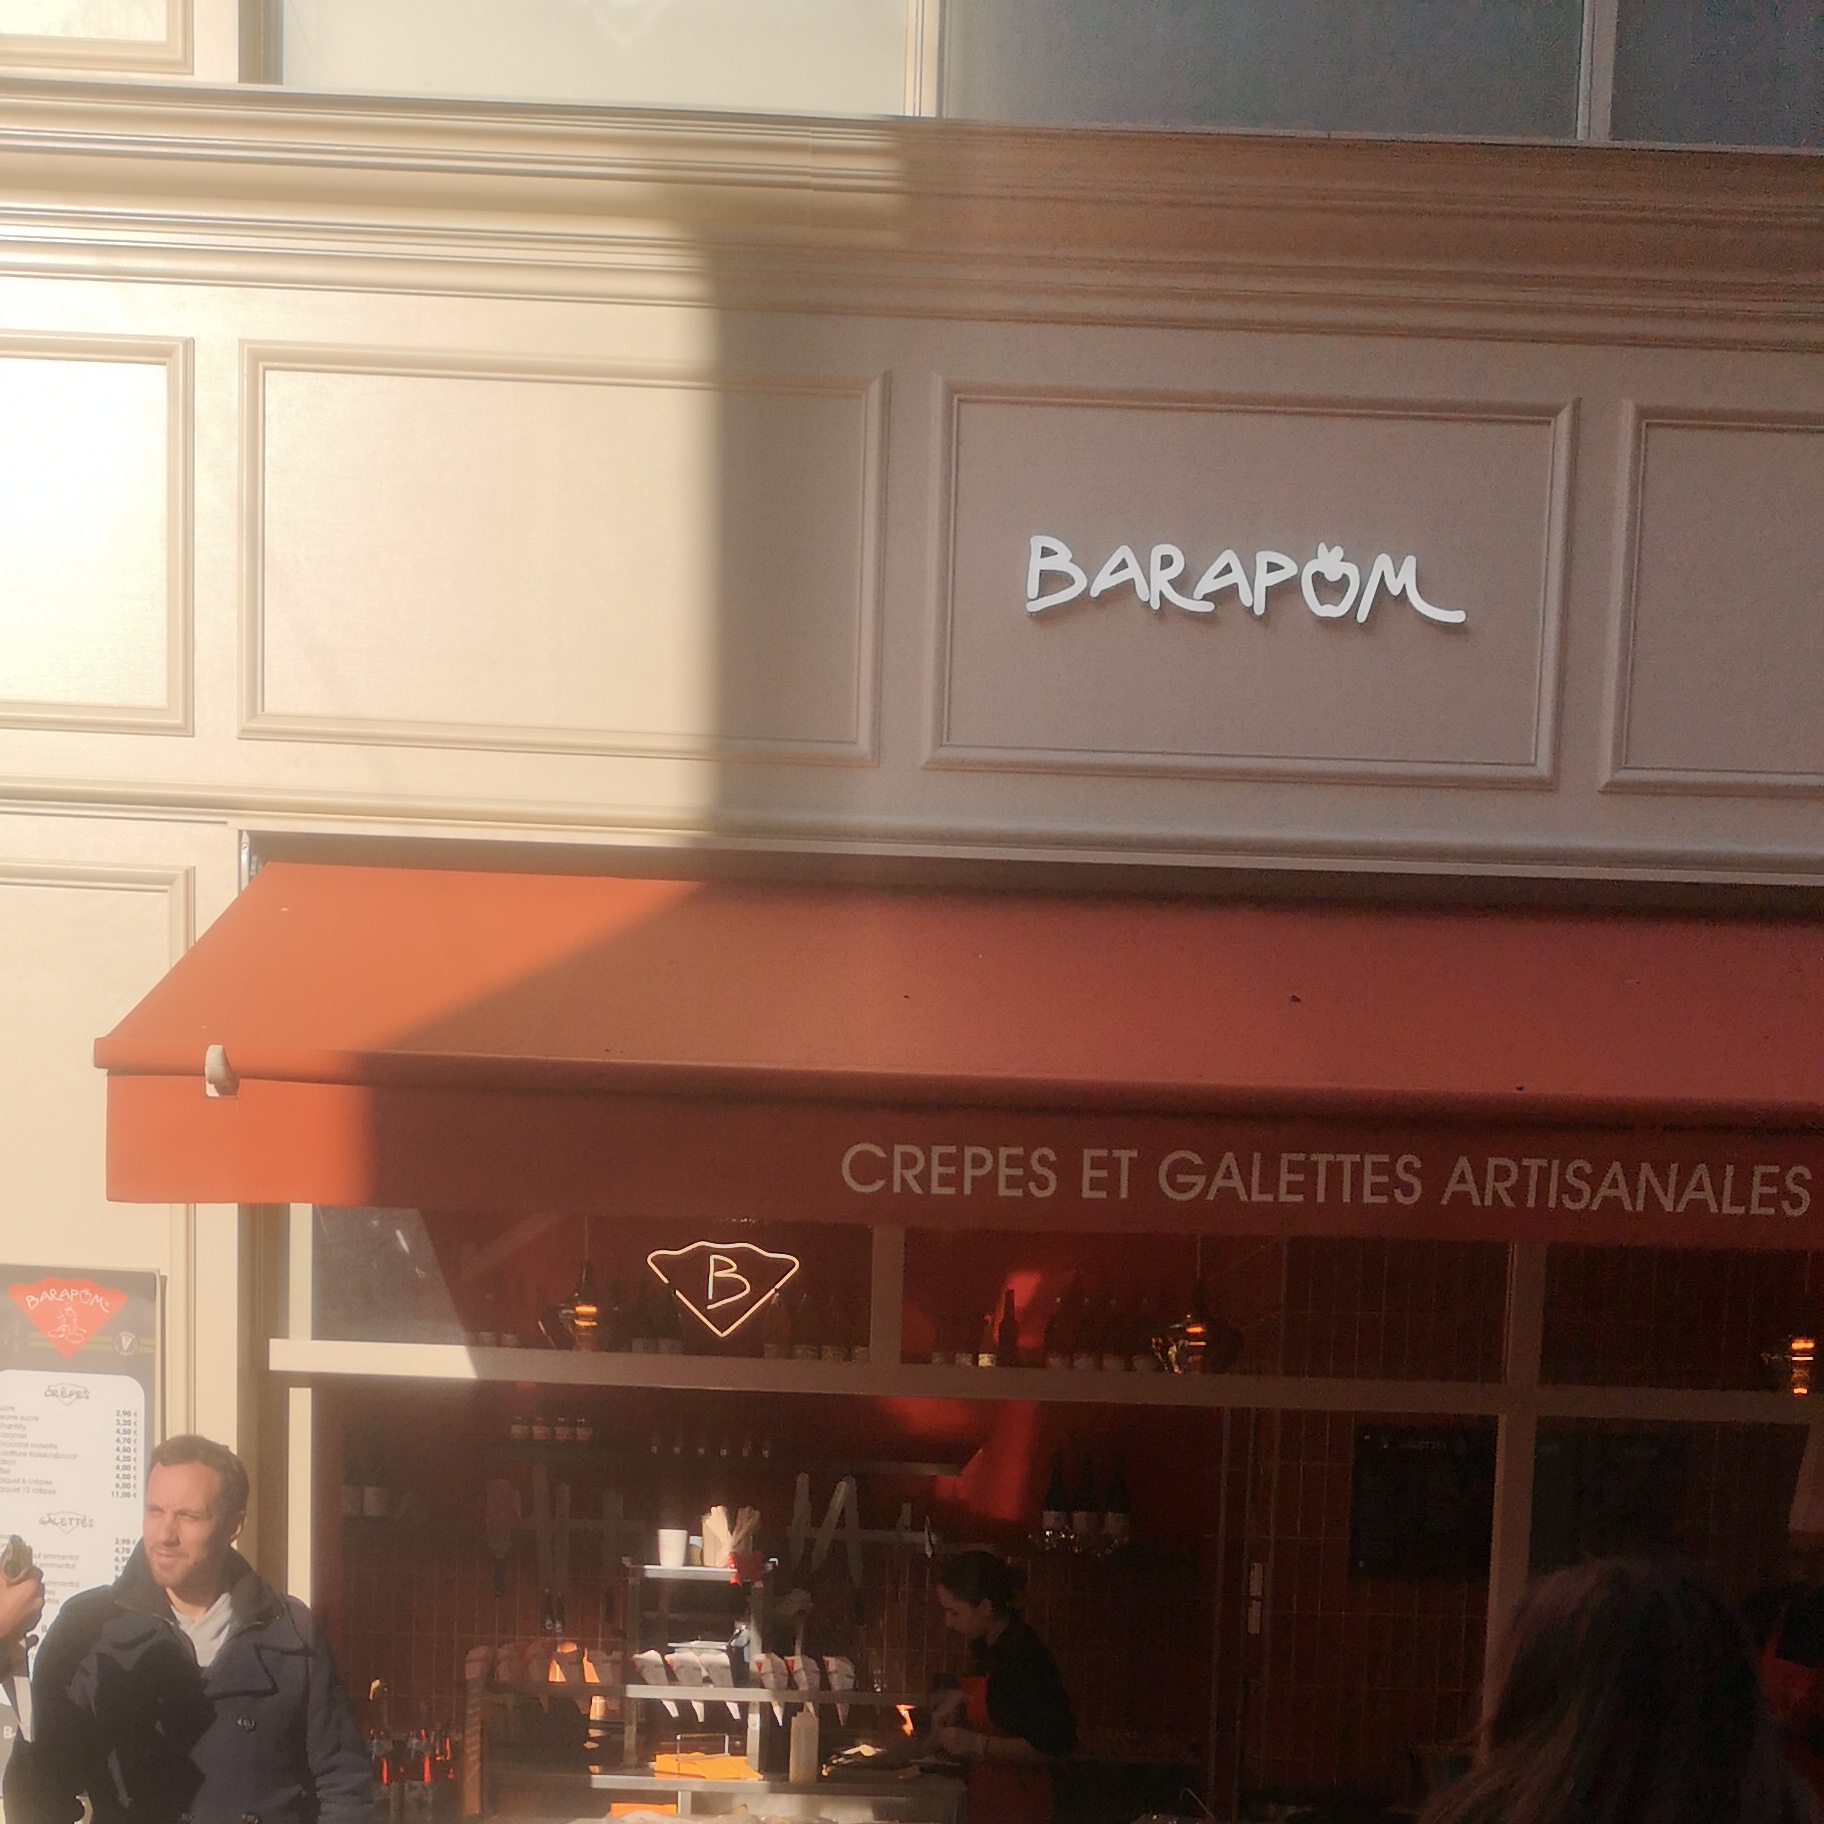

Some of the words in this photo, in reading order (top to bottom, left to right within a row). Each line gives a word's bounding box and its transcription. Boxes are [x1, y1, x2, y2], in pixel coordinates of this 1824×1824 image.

[841, 1142, 1058, 1199] CREPES
[1081, 1148, 1138, 1199] ET
[1158, 1150, 1423, 1206] GALETTES
[1441, 1156, 1812, 1217] ARTISANALES
[706, 1254, 750, 1310] B
